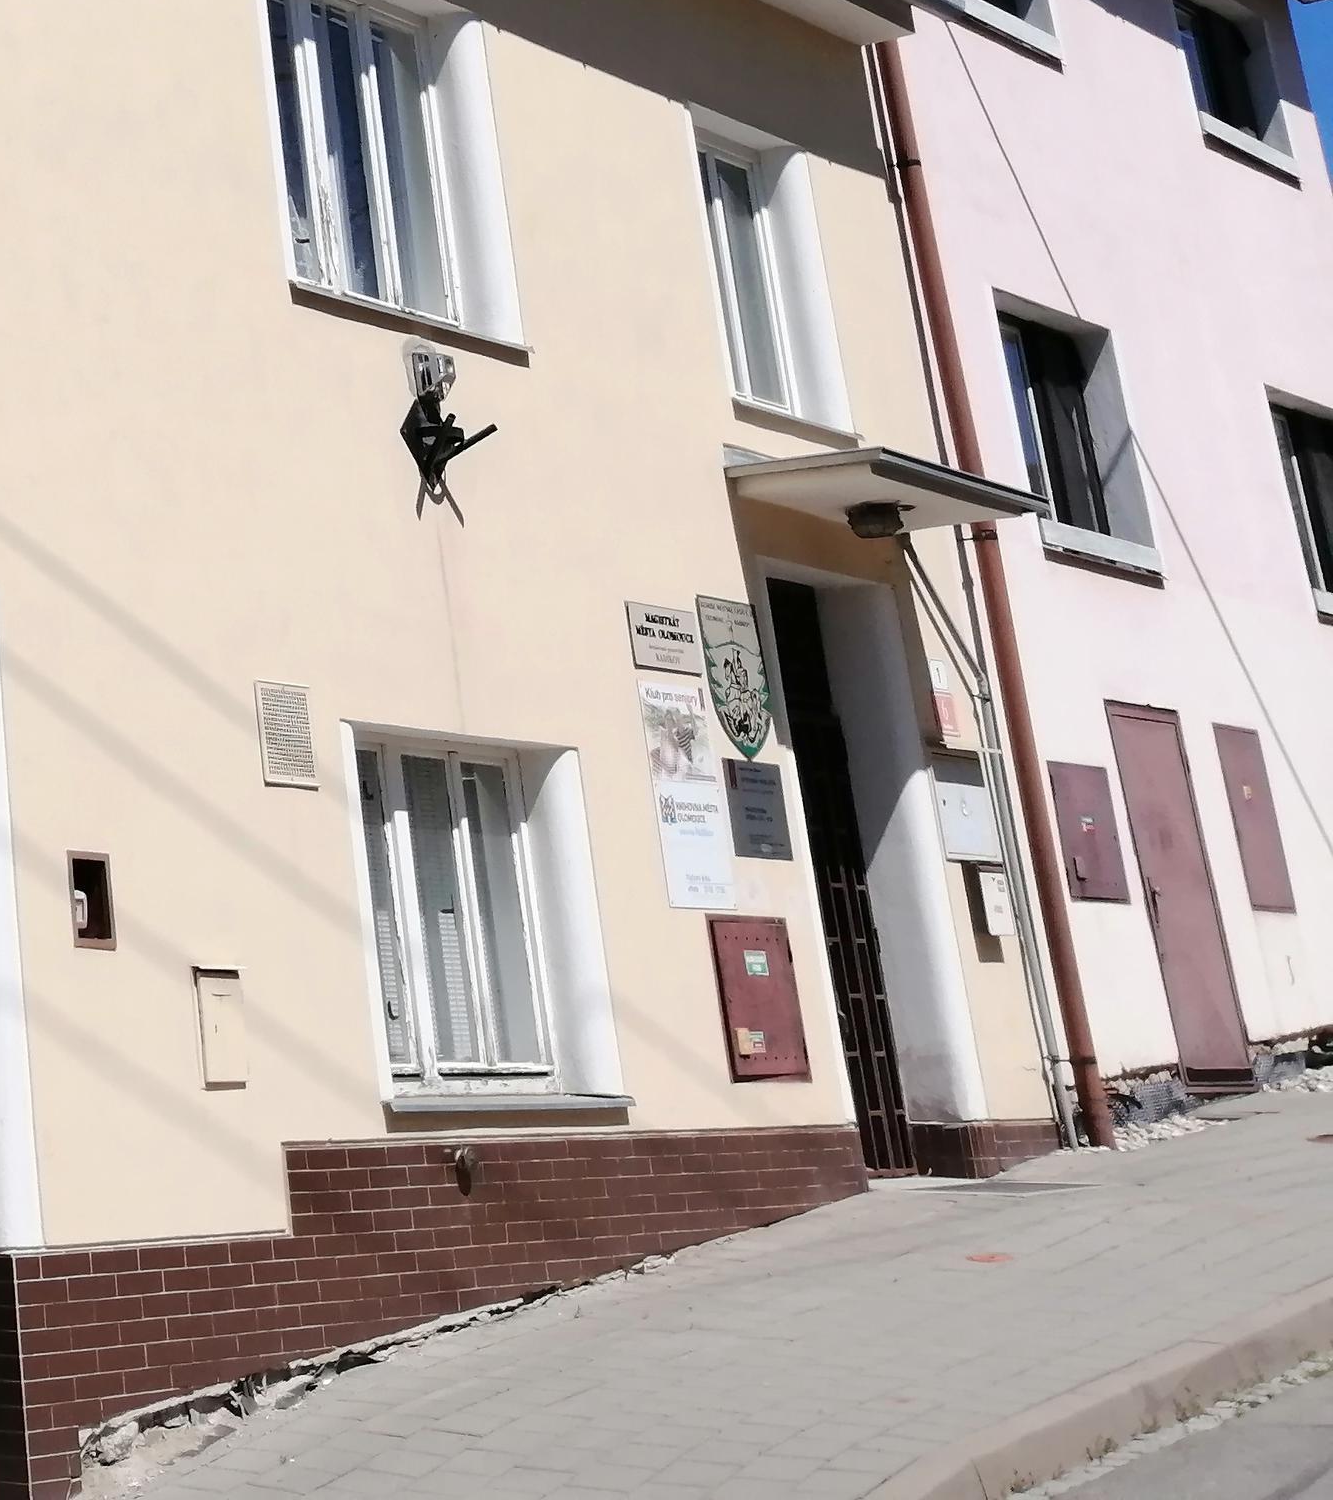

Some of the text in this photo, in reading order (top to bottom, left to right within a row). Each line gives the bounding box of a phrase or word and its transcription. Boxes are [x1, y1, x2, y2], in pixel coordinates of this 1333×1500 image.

[645, 612, 680, 628] MAGISTRÁT
[635, 624, 695, 644] MĚSTA OLOMOUCE
[644, 687, 698, 707] Klub pro seniory
